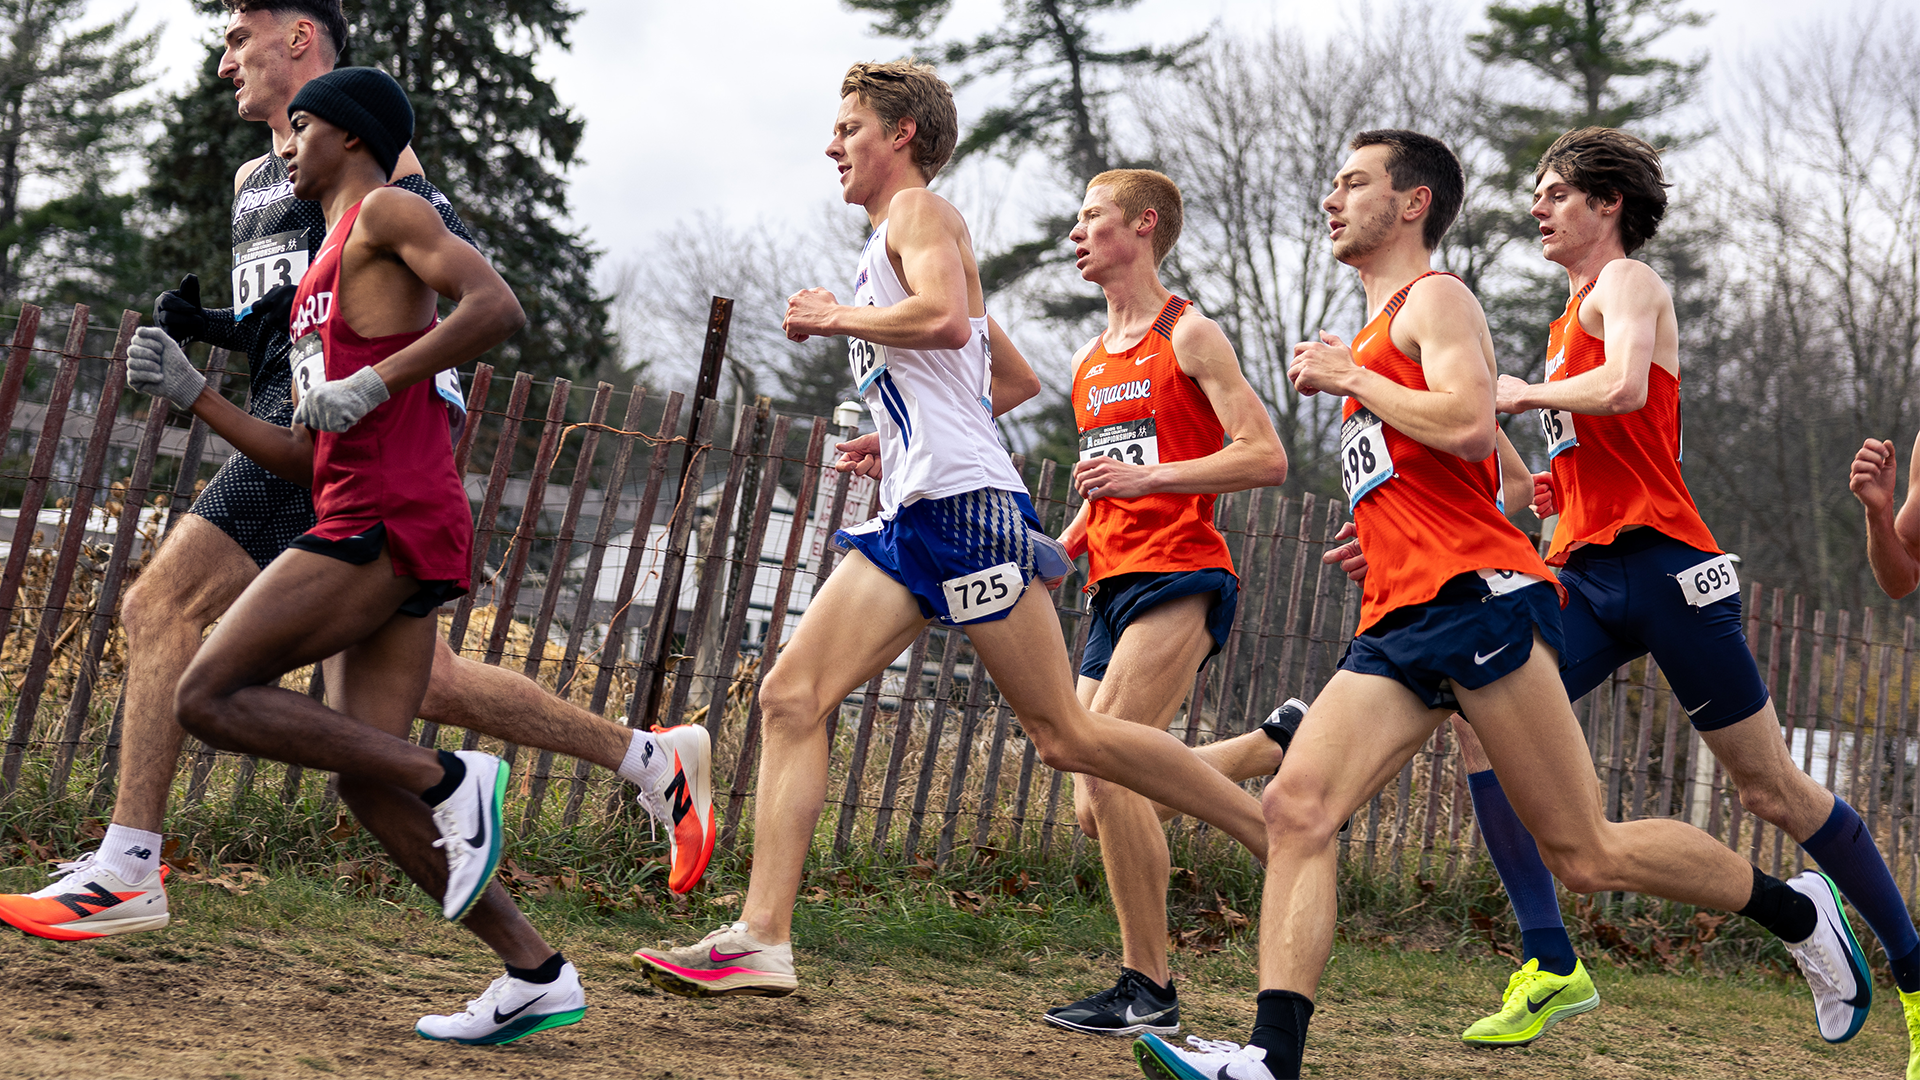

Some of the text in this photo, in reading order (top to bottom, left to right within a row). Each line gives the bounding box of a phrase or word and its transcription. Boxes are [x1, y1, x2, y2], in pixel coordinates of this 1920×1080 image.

[239, 257, 292, 304] 613
[1083, 362, 1107, 380] ACC
[1086, 378, 1151, 417] Syracuse
[1094, 431, 1136, 447] CHAMPIONSHIPS
[1543, 409, 1563, 445] 95
[954, 573, 1008, 609] 725
[1694, 563, 1730, 594] 695
